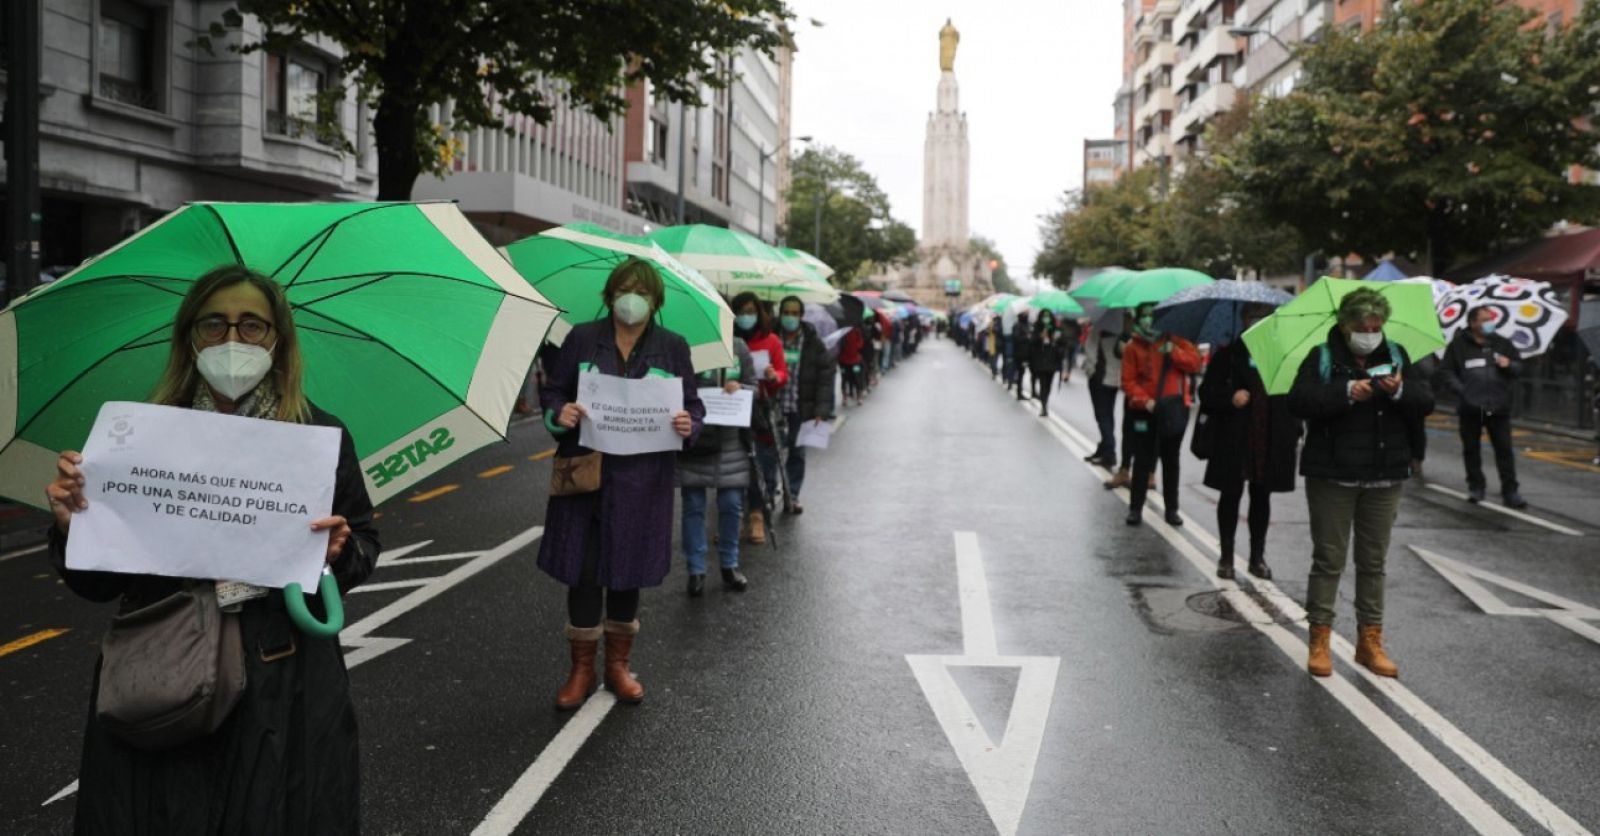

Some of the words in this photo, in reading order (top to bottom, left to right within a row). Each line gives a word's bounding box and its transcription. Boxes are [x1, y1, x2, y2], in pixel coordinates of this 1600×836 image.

[592, 402, 601, 410] EZ
[602, 404, 628, 414] GAUDE
[603, 415, 655, 425] MURRIZKETA
[130, 466, 175, 481] AHORA
[178, 471, 207, 485] MÁS
[209, 475, 237, 488] QUE
[239, 479, 284, 493] NUNCA
[102, 481, 138, 494] ¡POR
[142, 485, 173, 499] UNA
[177, 490, 242, 508] SANIDAD
[245, 496, 308, 515] PÚBLICA
[152, 502, 162, 513] Y
[165, 503, 185, 516] DE
[189, 507, 257, 525] CALIDAD!
